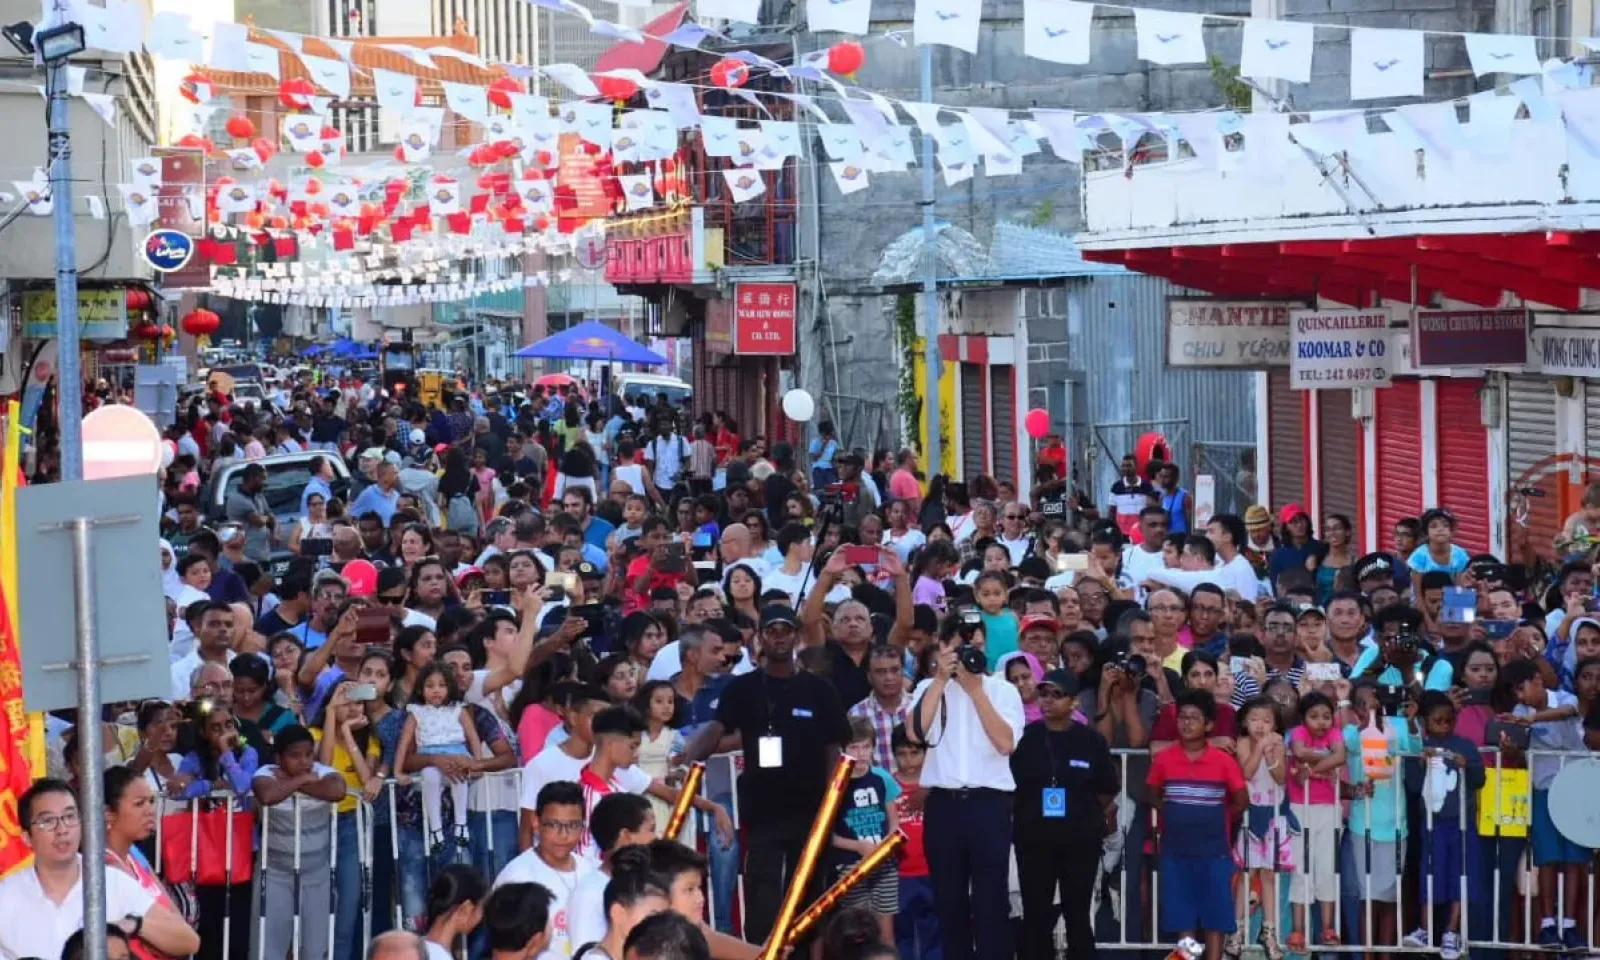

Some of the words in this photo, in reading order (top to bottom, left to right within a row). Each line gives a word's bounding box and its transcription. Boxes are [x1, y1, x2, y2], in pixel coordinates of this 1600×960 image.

[1297, 314, 1386, 334] QUINCAILLERIE
[1420, 316, 1447, 331] WONG
[1449, 316, 1480, 331] CHUNG
[1494, 315, 1525, 329] STORE
[1182, 340, 1226, 357] CHIU
[1297, 340, 1352, 358] KOOMAR
[1356, 340, 1366, 357] &
[1368, 338, 1386, 357] CO
[1543, 336, 1567, 368] WONG
[1568, 337, 1597, 369] CHUNG
[1299, 369, 1323, 381] TEL:
[1347, 367, 1371, 381] 0497
